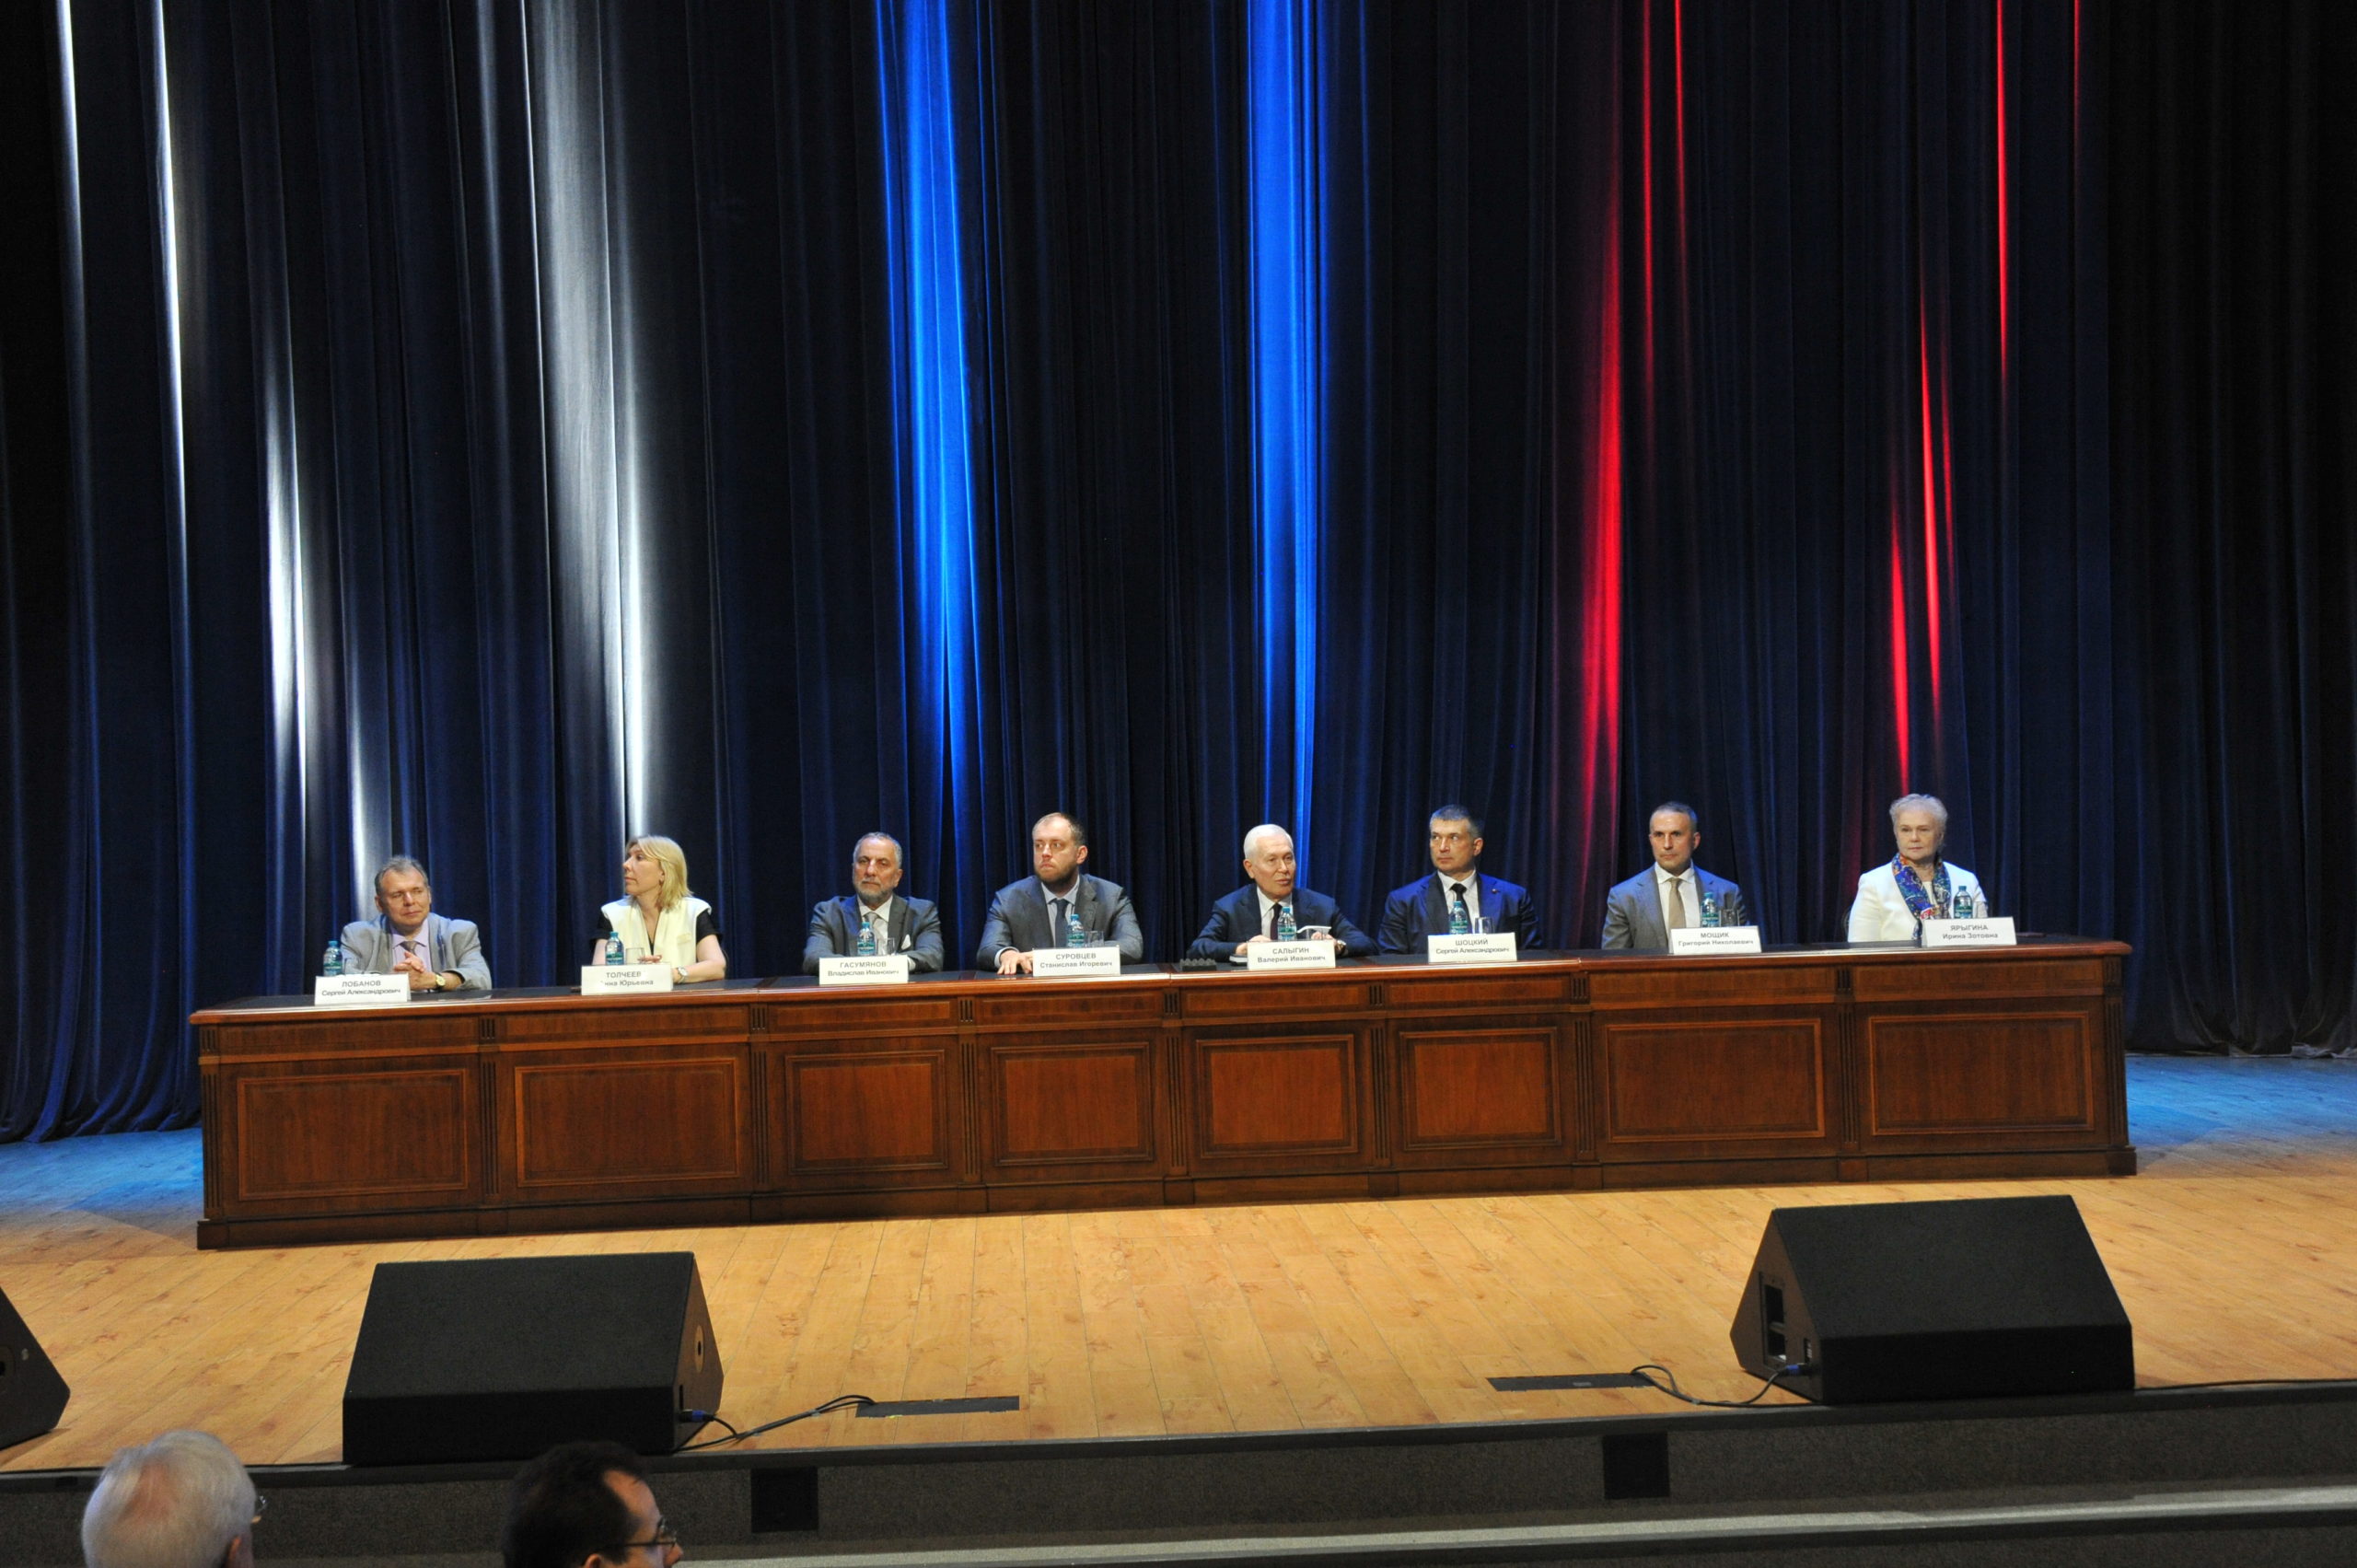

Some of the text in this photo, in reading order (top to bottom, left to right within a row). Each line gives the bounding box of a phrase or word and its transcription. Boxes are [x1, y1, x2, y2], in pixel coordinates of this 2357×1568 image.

[1456, 938, 1488, 947] ШОЦКИЙ
[1056, 952, 1097, 960] СУРОВЦЕВ
[1258, 956, 1288, 964] Валерий
[342, 980, 381, 988] ЛОБАНОВ
[620, 979, 654, 987] Юрьевна
